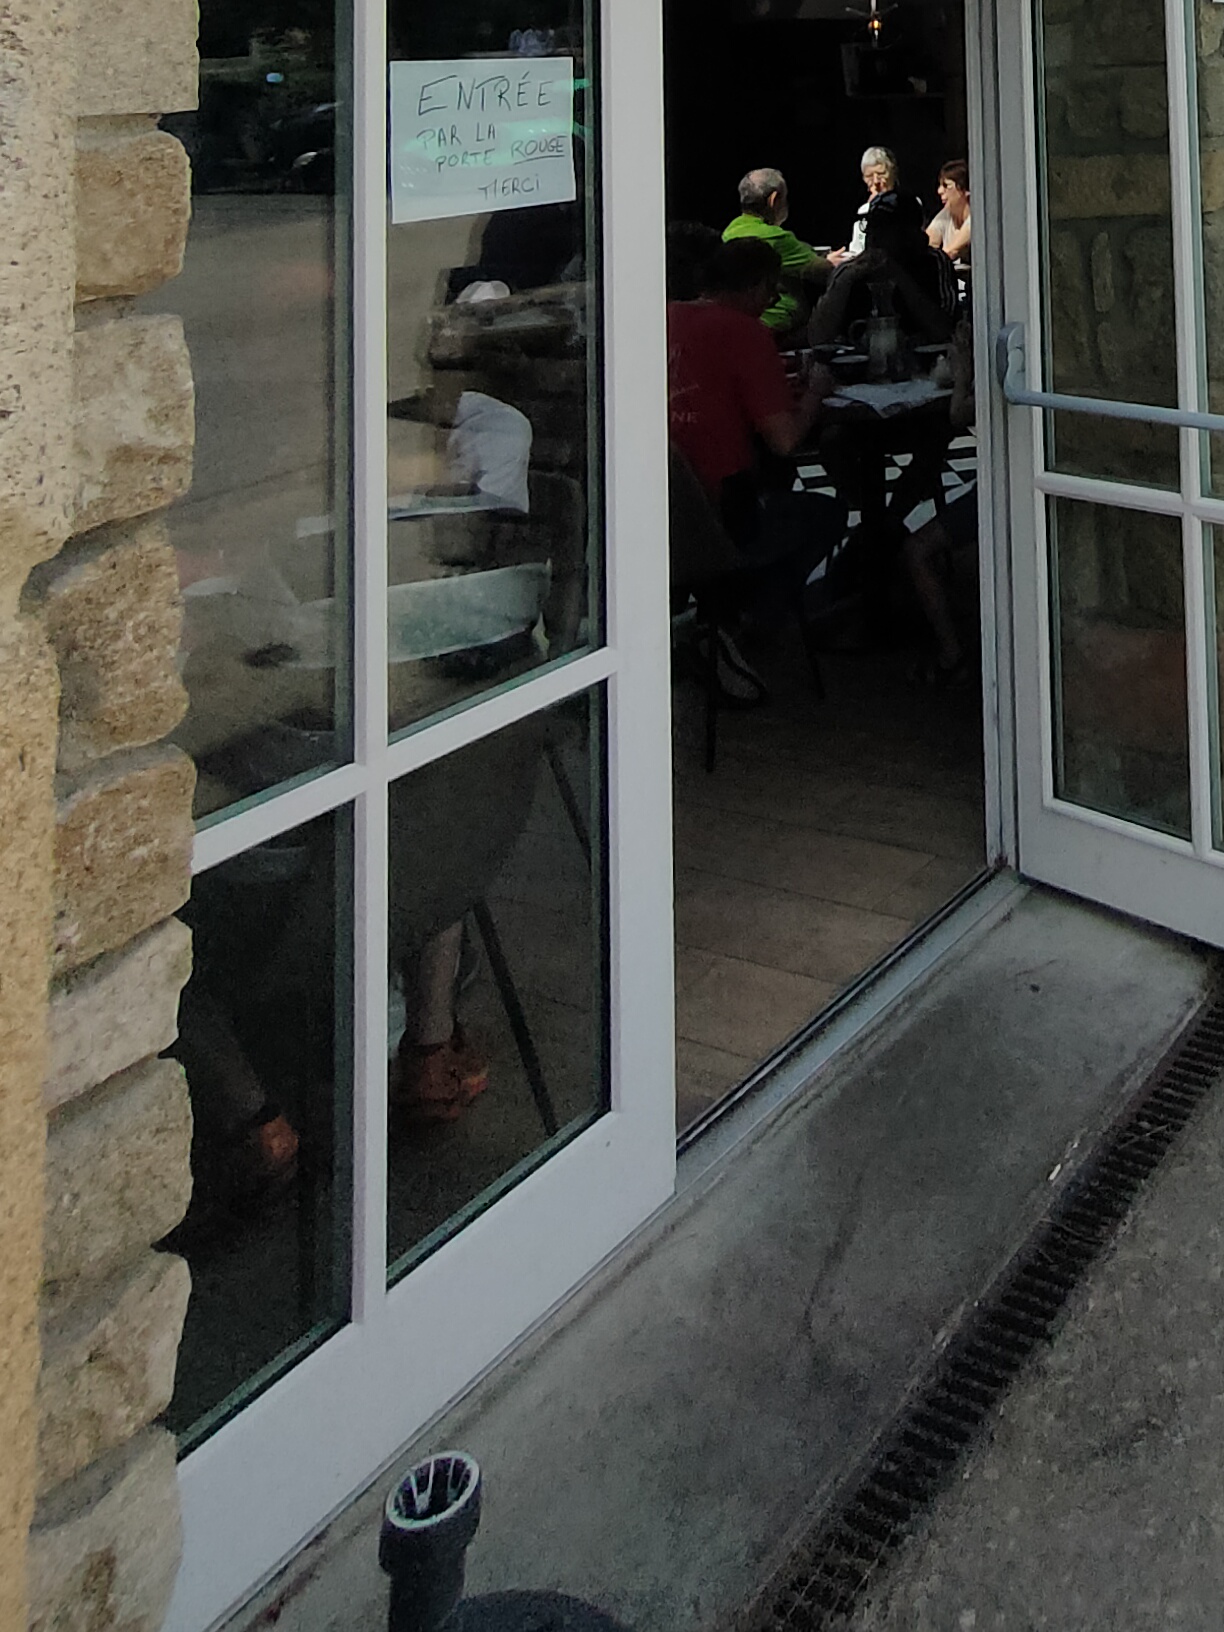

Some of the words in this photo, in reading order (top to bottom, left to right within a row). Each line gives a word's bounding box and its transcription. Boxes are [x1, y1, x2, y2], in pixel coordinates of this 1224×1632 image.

[418, 71, 553, 116] ENTRÉE
[416, 125, 462, 150] PAR
[475, 122, 496, 143] LA
[435, 149, 496, 172] PORTE
[510, 135, 567, 159] ROUGE
